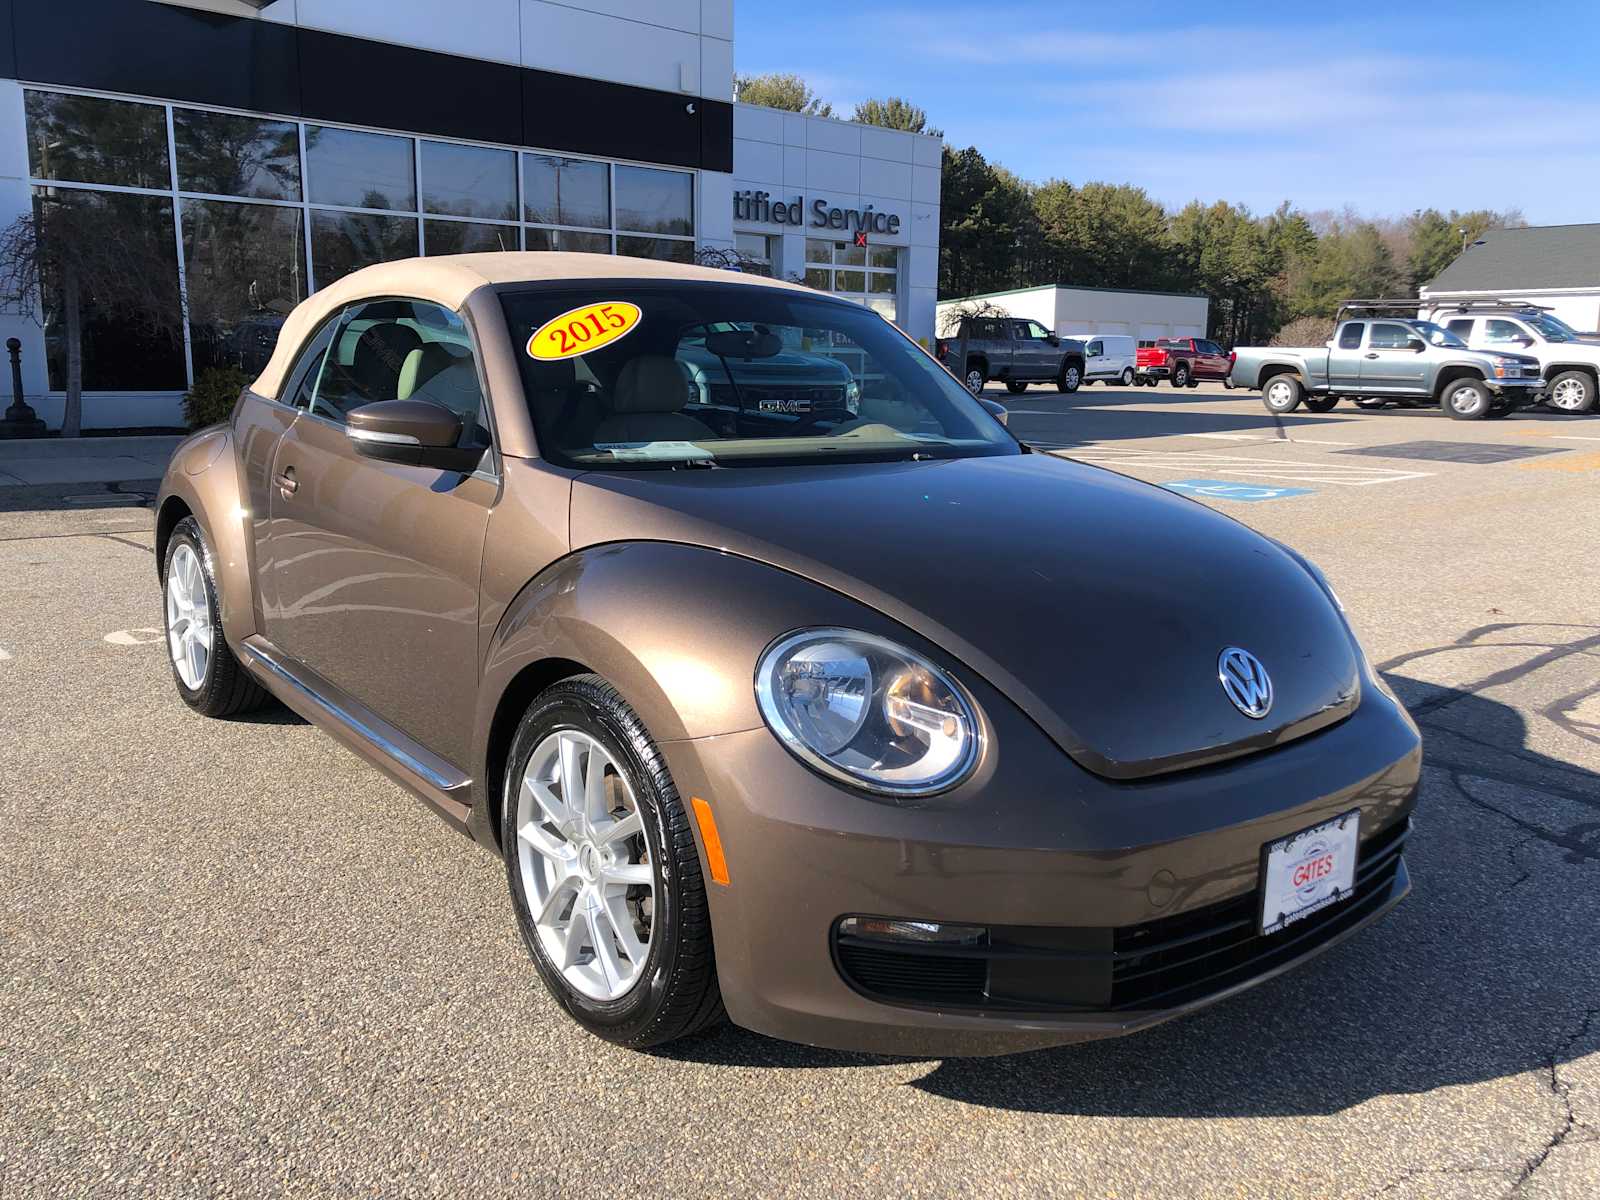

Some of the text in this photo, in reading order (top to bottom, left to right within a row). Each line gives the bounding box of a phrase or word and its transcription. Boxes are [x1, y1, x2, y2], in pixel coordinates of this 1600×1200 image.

[812, 199, 900, 235] Service
[549, 306, 626, 353] 2015
[759, 400, 811, 413] GMC
[1292, 854, 1333, 887] GATES
